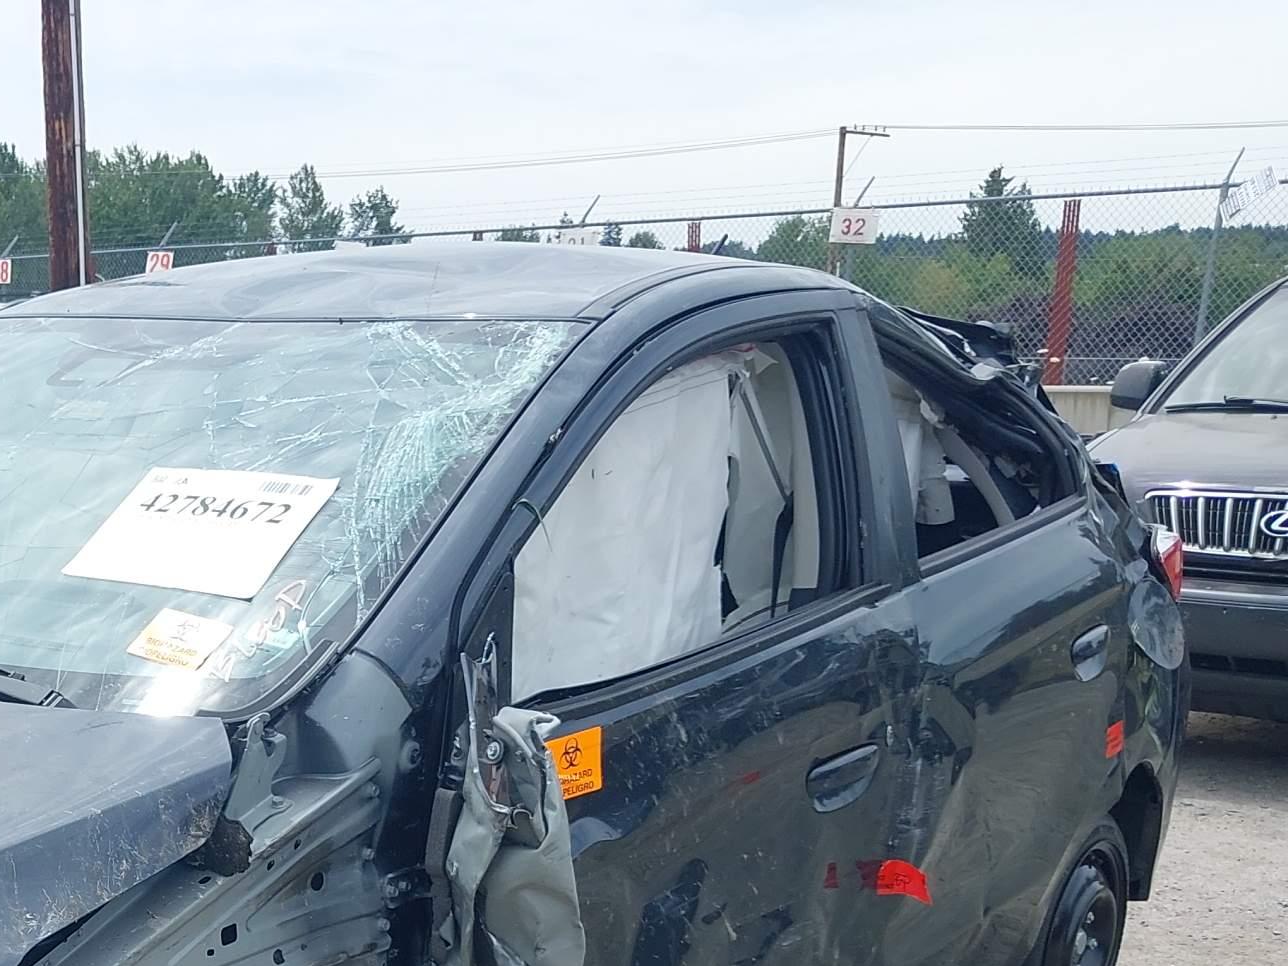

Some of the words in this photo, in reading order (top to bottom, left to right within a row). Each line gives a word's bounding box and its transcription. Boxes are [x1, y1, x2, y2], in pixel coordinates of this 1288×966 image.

[841, 218, 866, 236] 32
[150, 253, 170, 272] 29
[140, 493, 292, 524] 42784672
